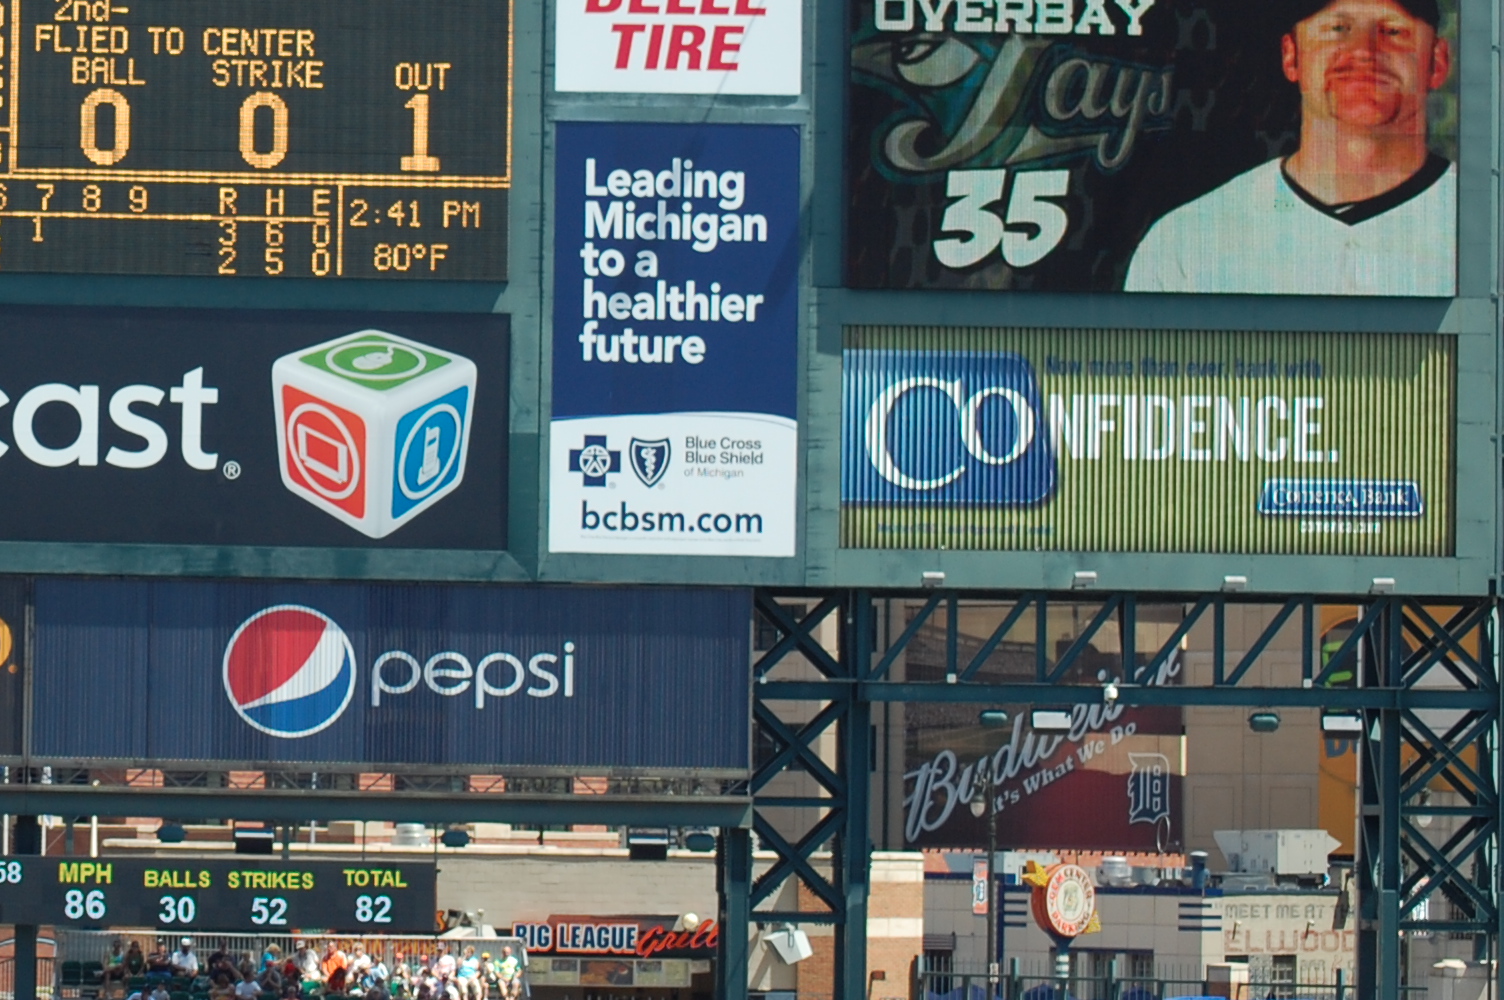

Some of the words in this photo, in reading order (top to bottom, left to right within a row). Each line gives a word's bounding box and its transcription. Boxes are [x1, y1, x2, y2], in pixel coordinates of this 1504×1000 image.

[34, 25, 129, 54] FLIED
[147, 27, 185, 55] TO
[202, 28, 316, 57] CENTER
[610, 23, 745, 72] TIRE
[71, 57, 146, 86] BALL
[211, 60, 324, 89] STRIKE
[395, 62, 451, 91] OUT
[79, 88, 131, 166] 0
[239, 91, 289, 169] 0
[399, 93, 441, 172] 1
[585, 157, 746, 211] Leading
[349, 199, 421, 228] 2:41
[443, 201, 481, 228] PM
[584, 200, 768, 253] Michigan
[933, 168, 1071, 269] 35
[373, 244, 449, 271] 80°F
[580, 242, 626, 277] to
[634, 249, 660, 278] a
[582, 278, 764, 322] healthier
[579, 320, 707, 364] future
[684, 435, 717, 450] Blue
[720, 436, 763, 450] Cross
[684, 450, 718, 465] Blue
[720, 450, 765, 466] Shield
[697, 467, 745, 480] Michigan
[580, 498, 764, 534] bcbsm.com
[370, 640, 577, 710] pepsi
[1023, 757, 1075, 796] What
[1076, 738, 1106, 765] We
[1109, 721, 1138, 746] Do
[58, 862, 113, 885] MPH
[143, 869, 211, 889] BALLS
[227, 871, 314, 890] STRIKES
[343, 868, 407, 888] TOTAL
[64, 889, 107, 920] 86
[158, 896, 196, 924] 30
[251, 897, 288, 926] 52
[355, 895, 393, 924] 82
[514, 923, 551, 948] BIG
[559, 925, 636, 950] LEAGUE
